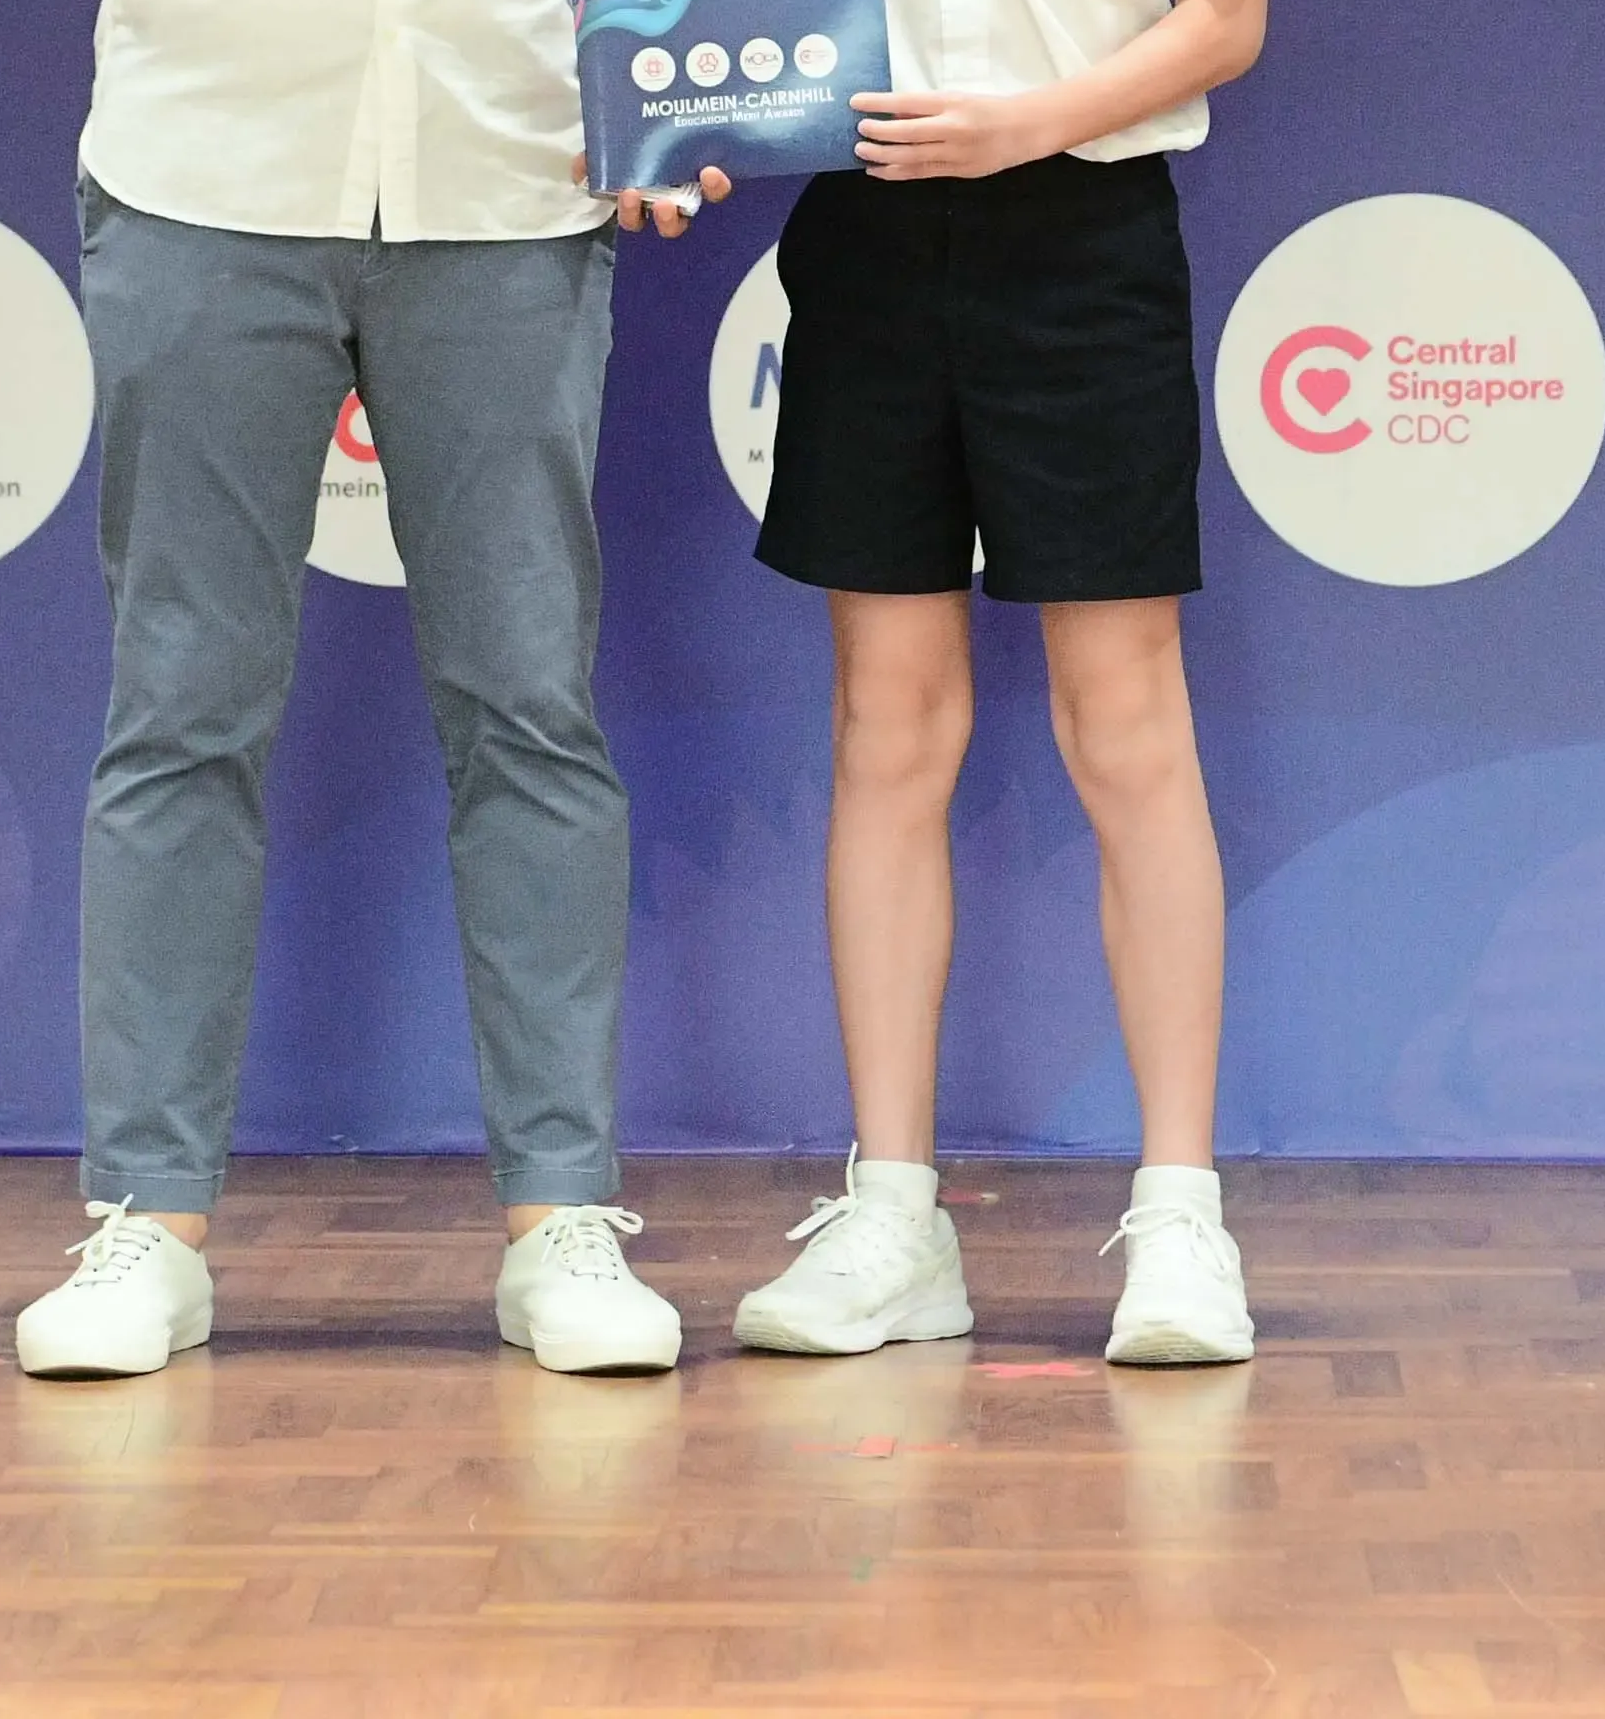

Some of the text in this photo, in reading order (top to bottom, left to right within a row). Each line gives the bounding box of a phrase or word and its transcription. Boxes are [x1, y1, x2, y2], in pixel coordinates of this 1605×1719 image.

[642, 87, 835, 118] MOULMEIN-CAIRNHILL
[1387, 336, 1516, 365] Central
[1387, 371, 1564, 407] Singapore
[1387, 414, 1470, 444] CDC
